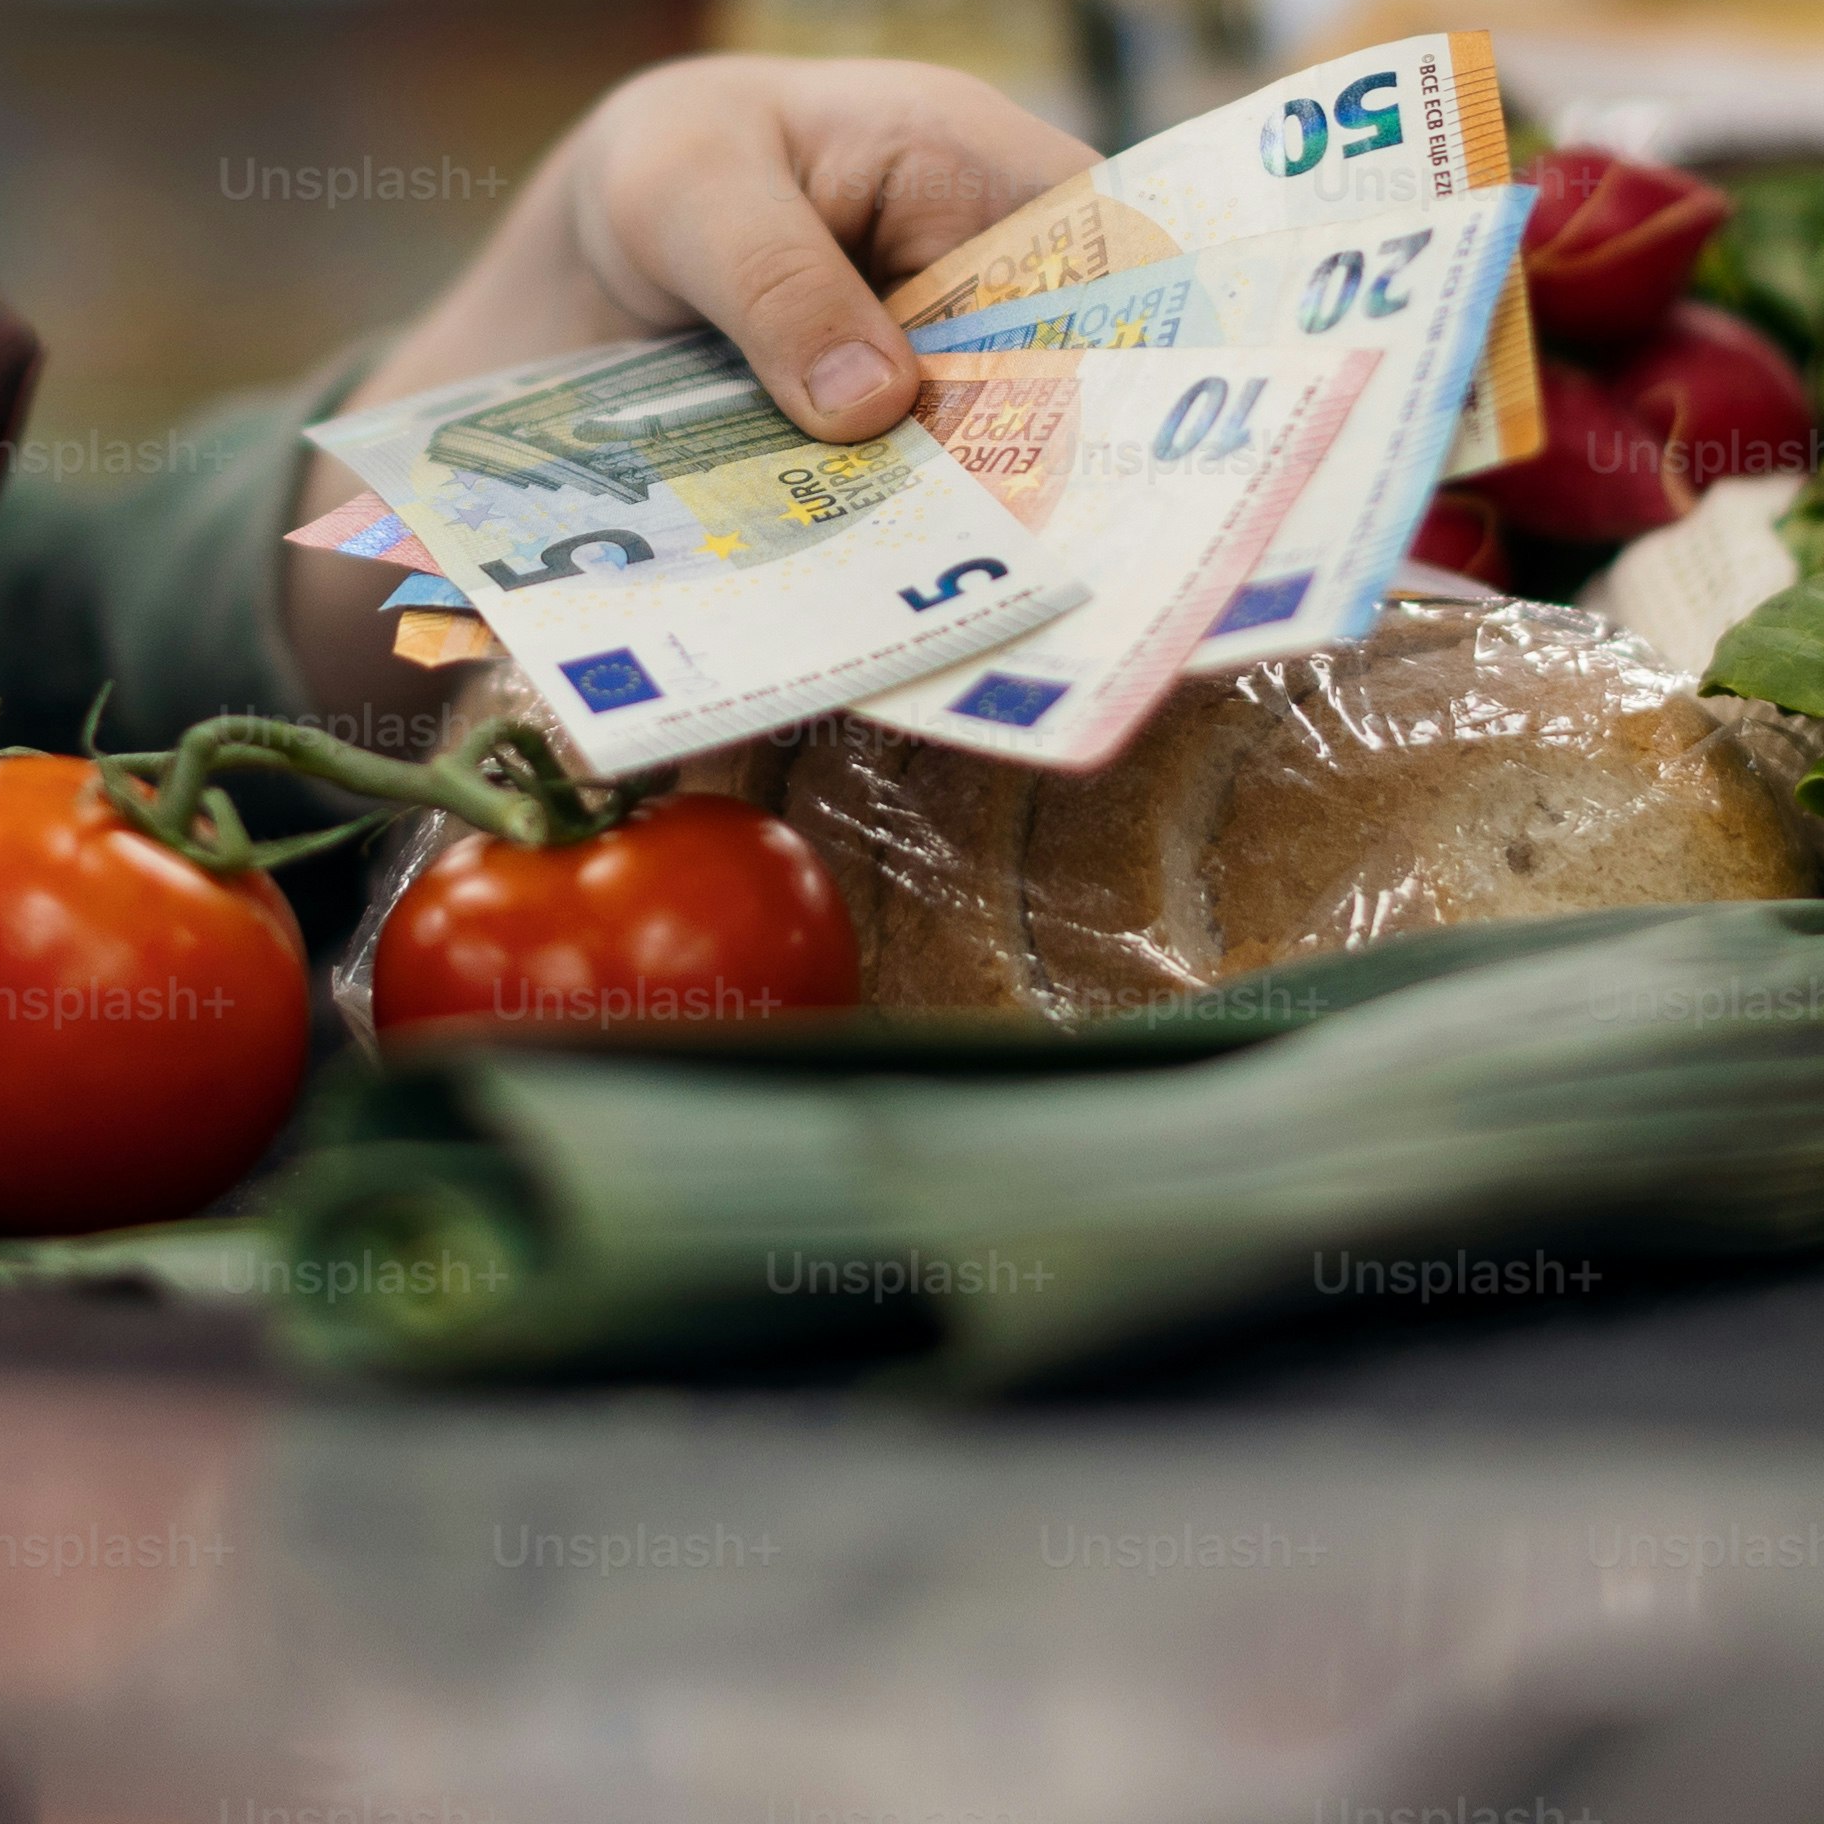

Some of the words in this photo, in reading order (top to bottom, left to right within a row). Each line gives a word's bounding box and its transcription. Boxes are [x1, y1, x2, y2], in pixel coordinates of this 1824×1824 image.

[1259, 71, 1404, 178] 50
[1424, 98, 1443, 130] ECB
[1298, 227, 1434, 335] 20
[1152, 376, 1269, 462] 10
[777, 468, 849, 524] EURO
[479, 528, 656, 593] 5
[898, 557, 1010, 613] 5
